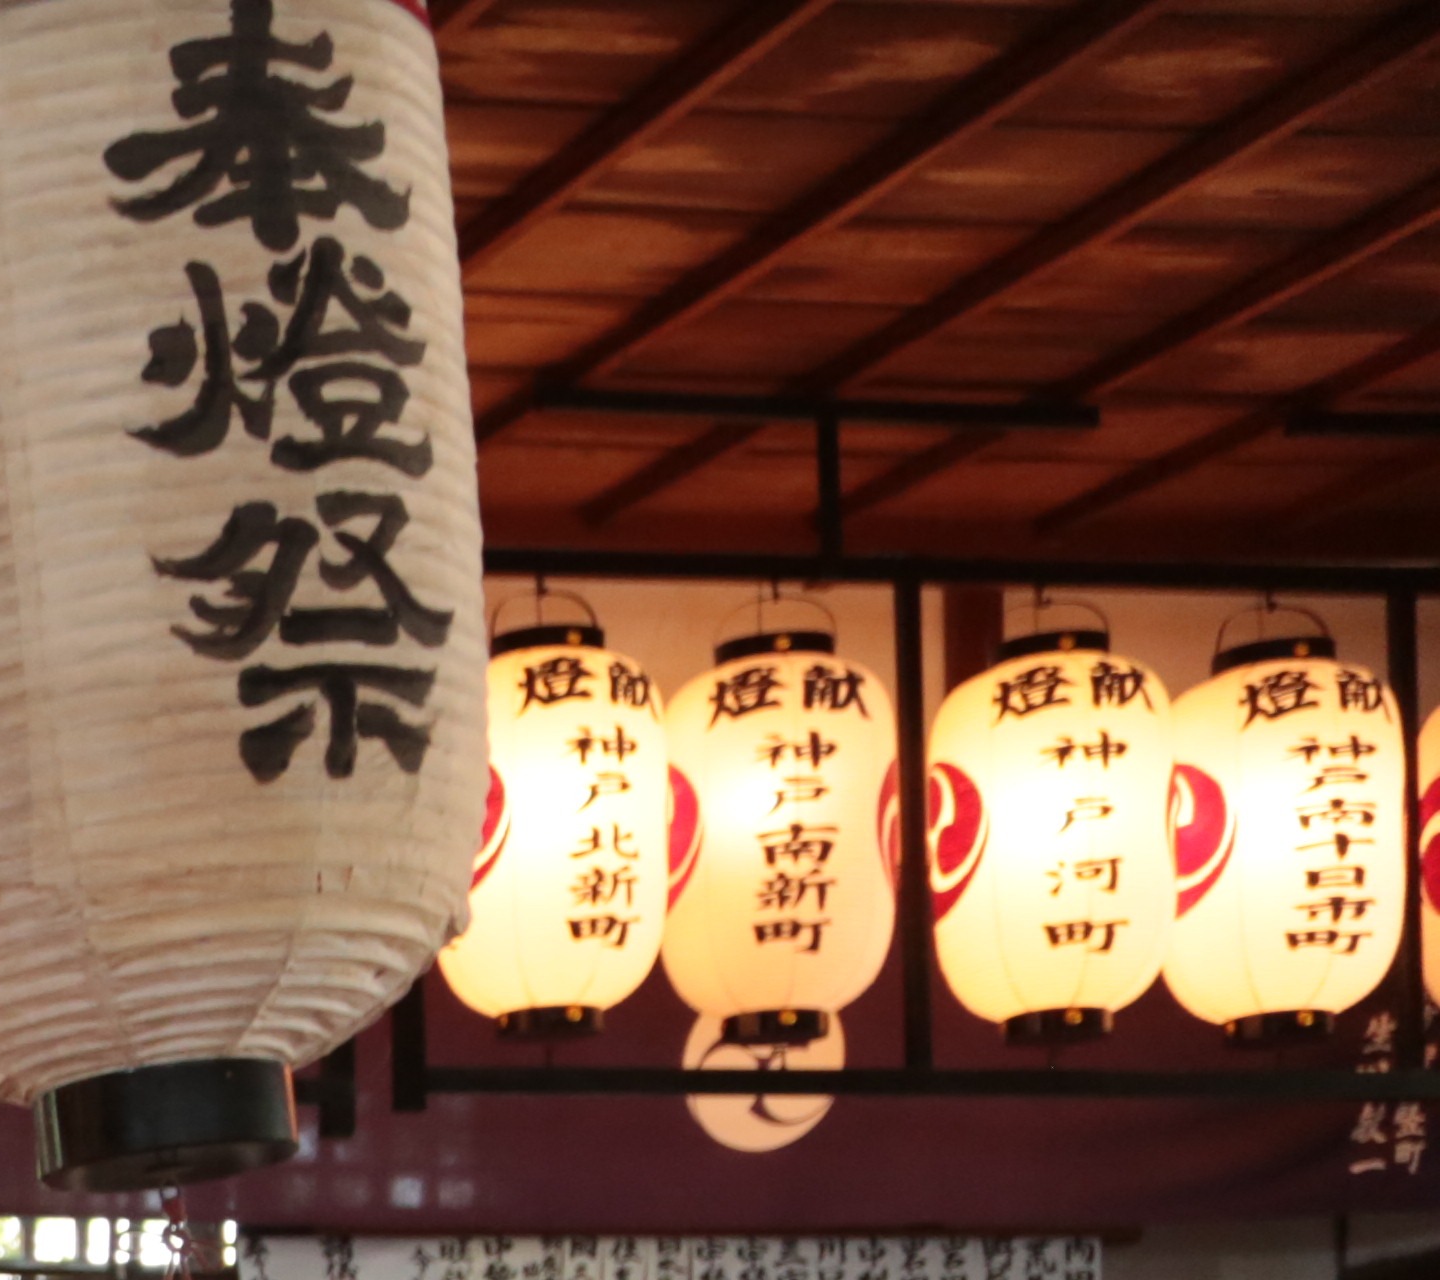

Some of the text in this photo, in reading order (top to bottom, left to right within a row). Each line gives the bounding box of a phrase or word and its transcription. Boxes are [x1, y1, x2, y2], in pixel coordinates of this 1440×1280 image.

[103, 0, 454, 783] 奉燈祭
[566, 725, 642, 948] 神戸北新町
[754, 731, 839, 954] 神戸南新町
[1038, 730, 1130, 955] 神戸河町
[1284, 735, 1379, 956] 神戸南十日市町
